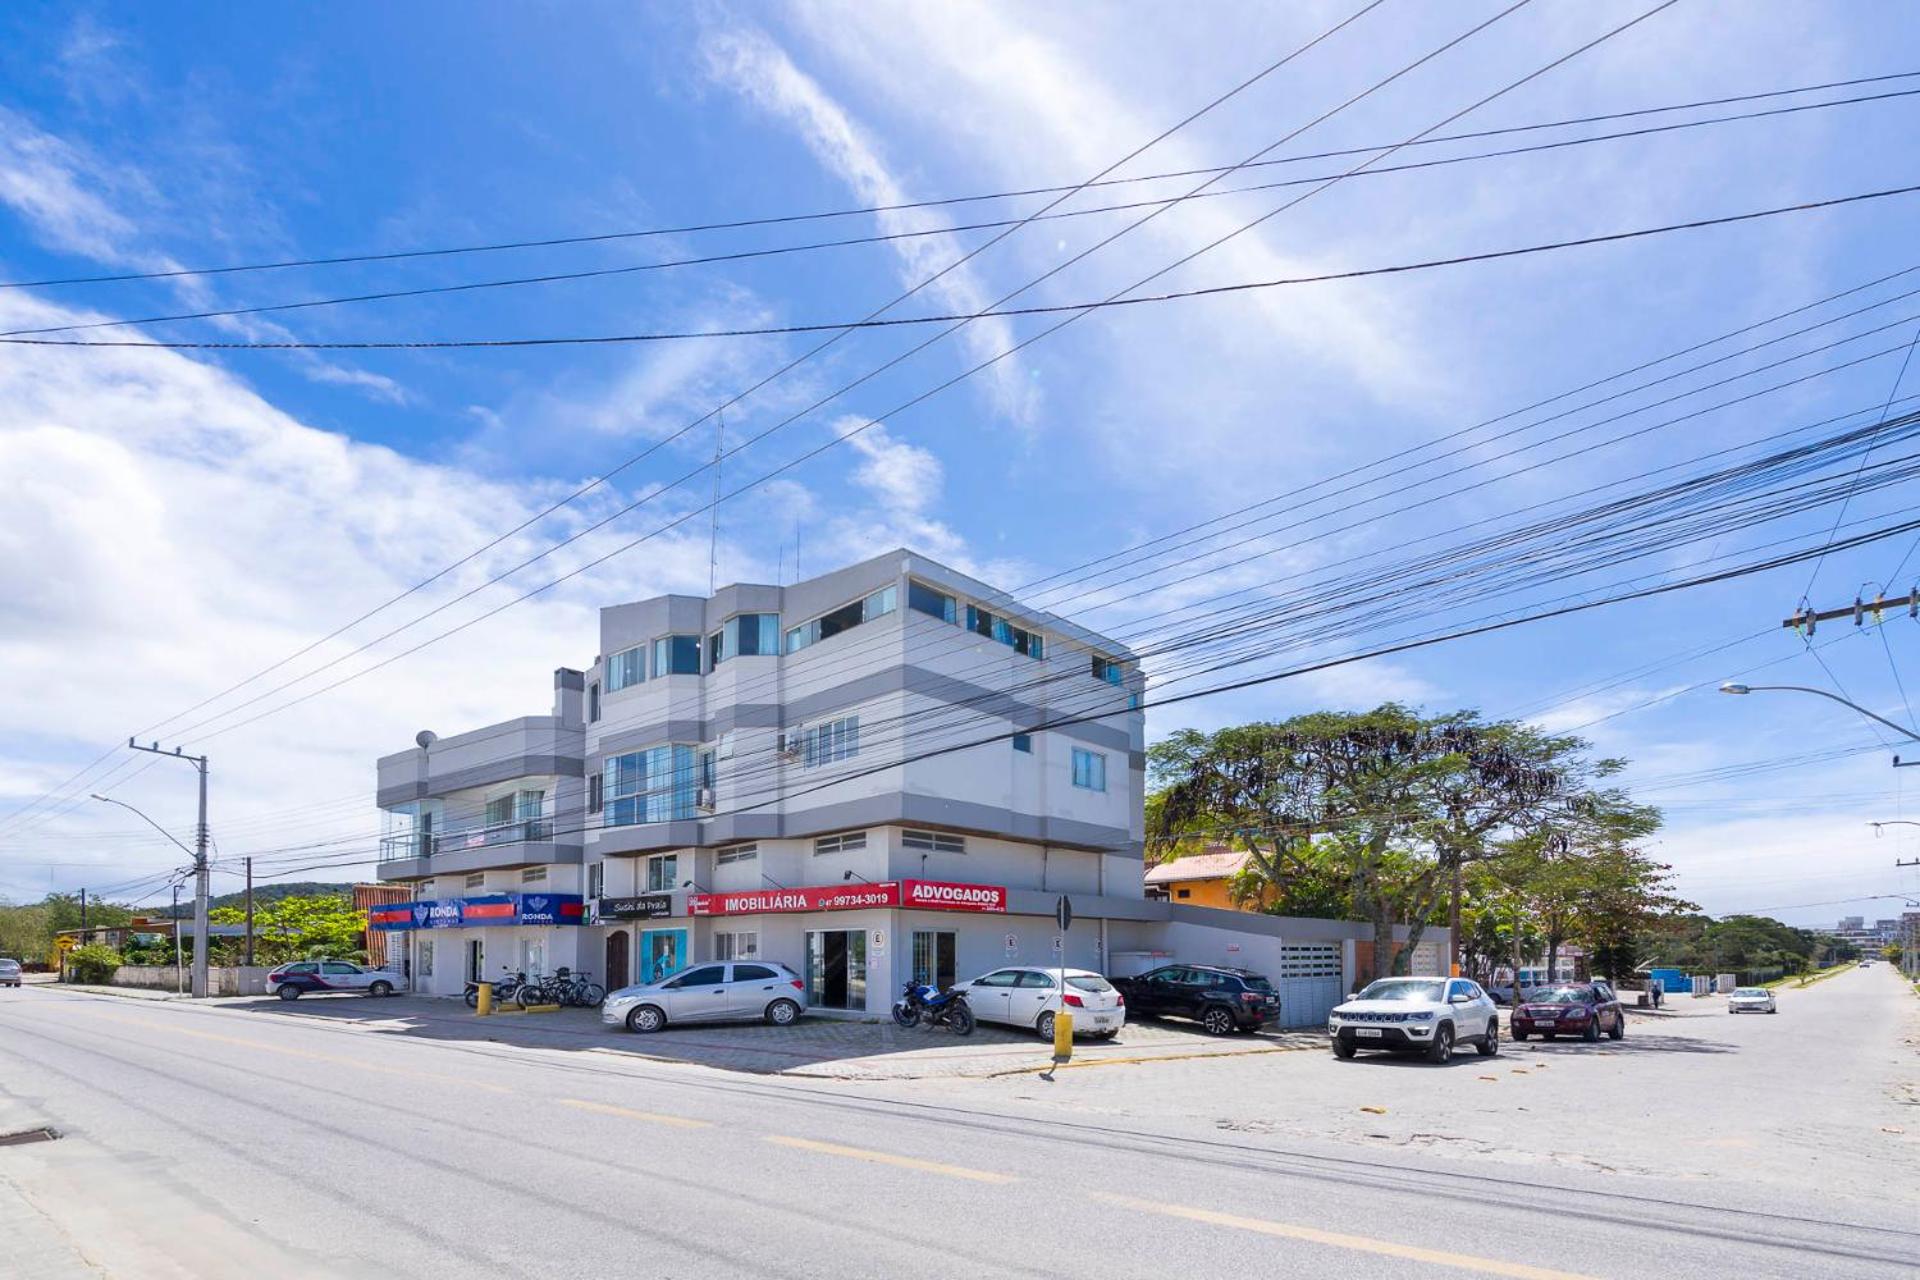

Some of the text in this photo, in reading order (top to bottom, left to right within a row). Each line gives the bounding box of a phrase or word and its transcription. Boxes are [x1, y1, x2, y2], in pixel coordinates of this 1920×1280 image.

[725, 893, 807, 911] IMOBILIÁRIA
[834, 893, 888, 906] 99734-3019
[912, 885, 999, 903] ADVOGADOS
[430, 906, 458, 918] RONDA
